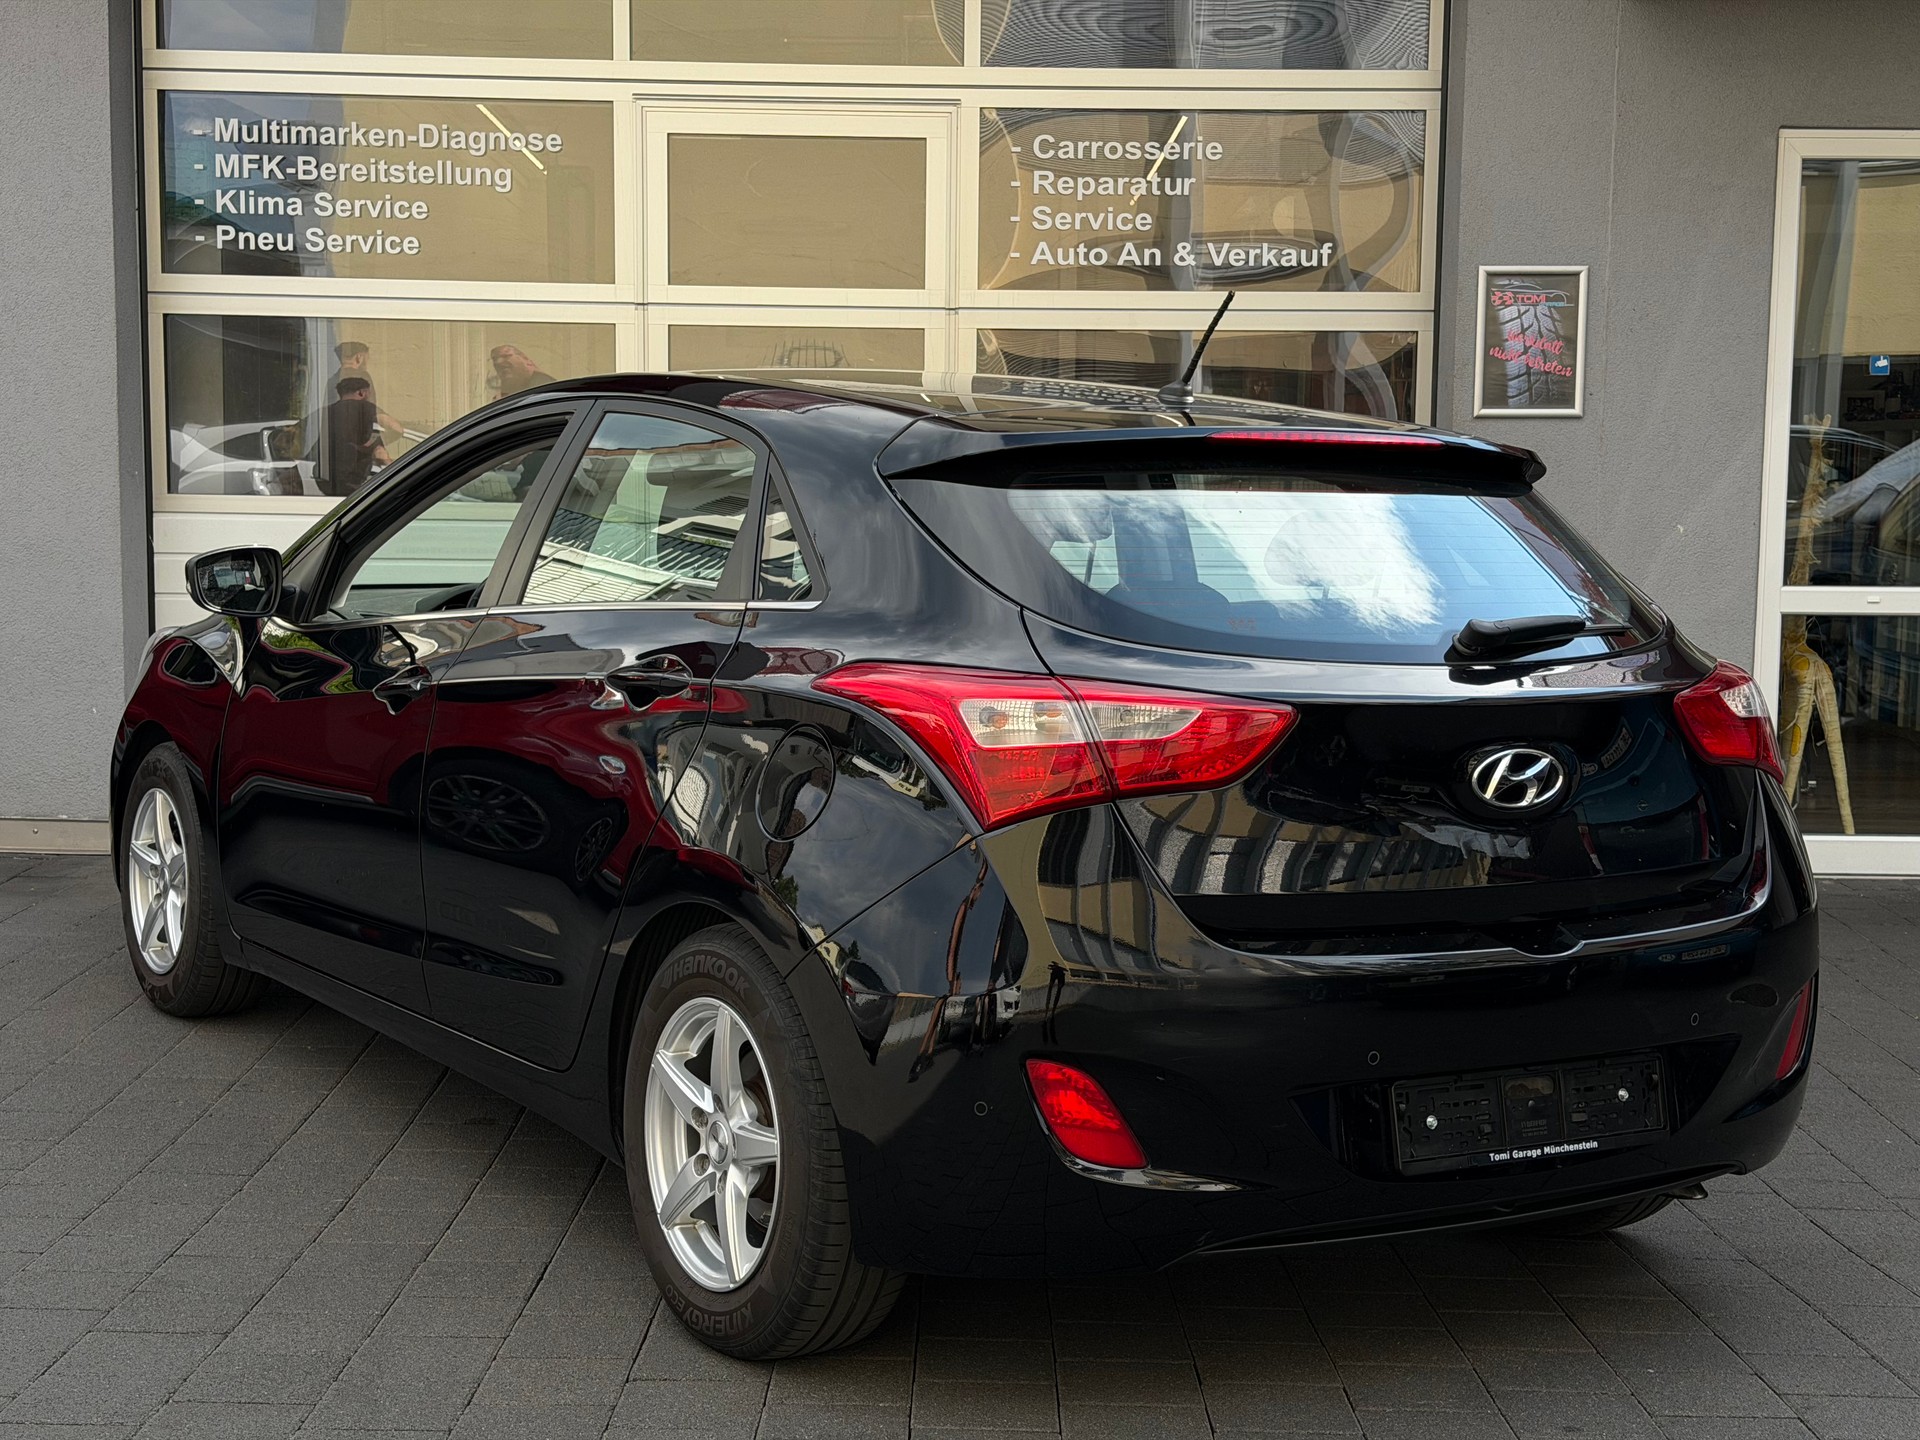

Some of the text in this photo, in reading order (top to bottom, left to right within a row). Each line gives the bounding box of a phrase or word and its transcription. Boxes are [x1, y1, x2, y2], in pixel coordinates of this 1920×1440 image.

[214, 117, 563, 156] Multimarken-Diagnose
[1032, 134, 1223, 161] Carrosserie
[214, 154, 513, 193] MFK-Bereitstellung
[1032, 170, 1196, 199] Reparatur
[215, 190, 304, 217] Klima
[313, 192, 429, 221] Service
[1031, 206, 1153, 231] Service
[216, 226, 295, 252] Pneu
[304, 227, 421, 255] Service
[1030, 242, 1108, 267] Auto
[1117, 242, 1162, 267] An
[1173, 242, 1197, 267] &
[1207, 242, 1333, 268] Verkauf
[1516, 294, 1547, 304] TOMI
[1524, 352, 1573, 377] betreten
[1489, 1140, 1598, 1161] Tomi Garage Münchenstein
